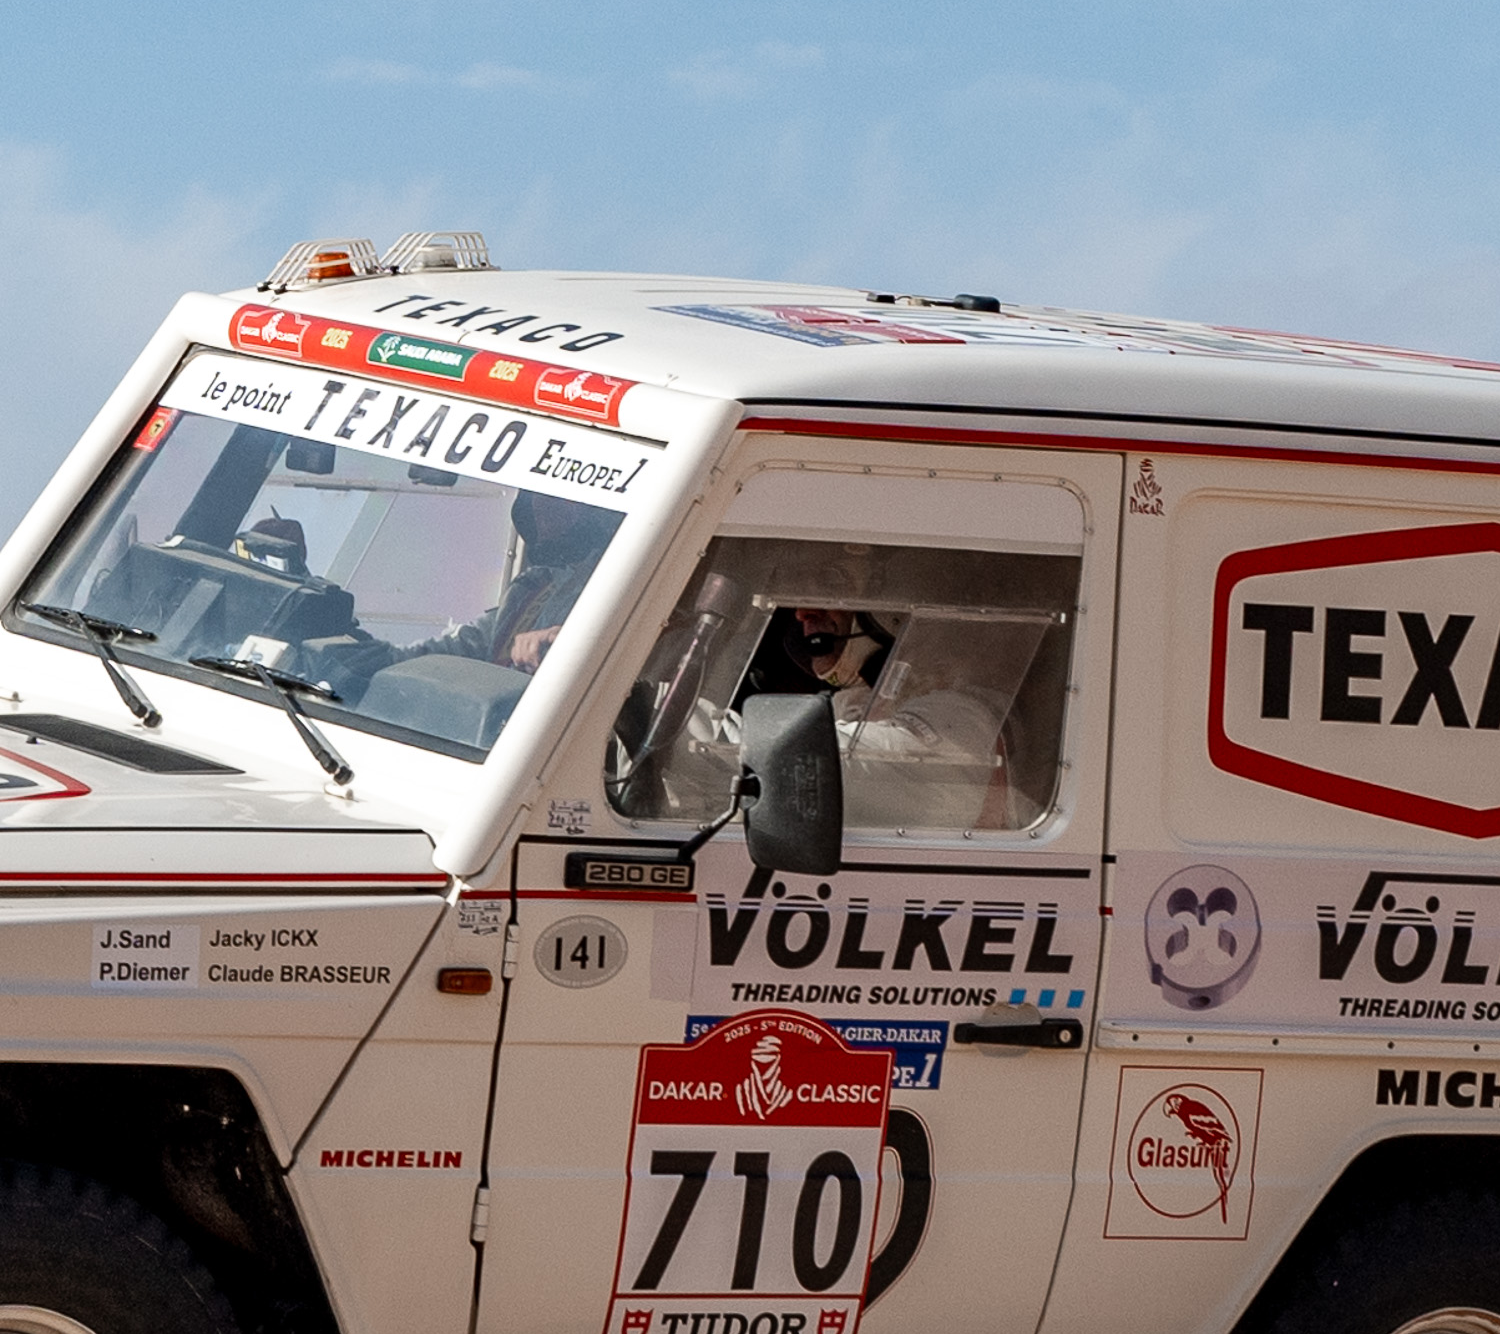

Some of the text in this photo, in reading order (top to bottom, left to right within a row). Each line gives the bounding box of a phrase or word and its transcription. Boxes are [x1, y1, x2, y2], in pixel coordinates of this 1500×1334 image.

[374, 295, 627, 352] TEXACO
[320, 327, 354, 349] 2025
[488, 359, 524, 382] 2025
[201, 371, 234, 403] le
[228, 380, 292, 415] point
[303, 380, 528, 474] TEXACO
[588, 864, 686, 884] 280 GE
[706, 867, 1074, 973] VÖLKEL
[100, 929, 171, 949] J.Sand
[209, 929, 319, 952] Jacky ICKX
[553, 935, 606, 971] 141
[99, 962, 190, 982] P.Diemer
[208, 964, 391, 985] Claude BRASSEUR
[731, 982, 998, 1007] THREADING SOLUTIONS
[1338, 997, 1467, 1020] THREADING
[723, 1023, 752, 1044] 2025
[778, 1020, 823, 1046] EDITION
[648, 1080, 882, 1103] DAKAR CLASSIC
[320, 1150, 463, 1168] MICHELIN
[1137, 1137, 1231, 1168] Glasurit
[631, 1149, 863, 1293] 710
